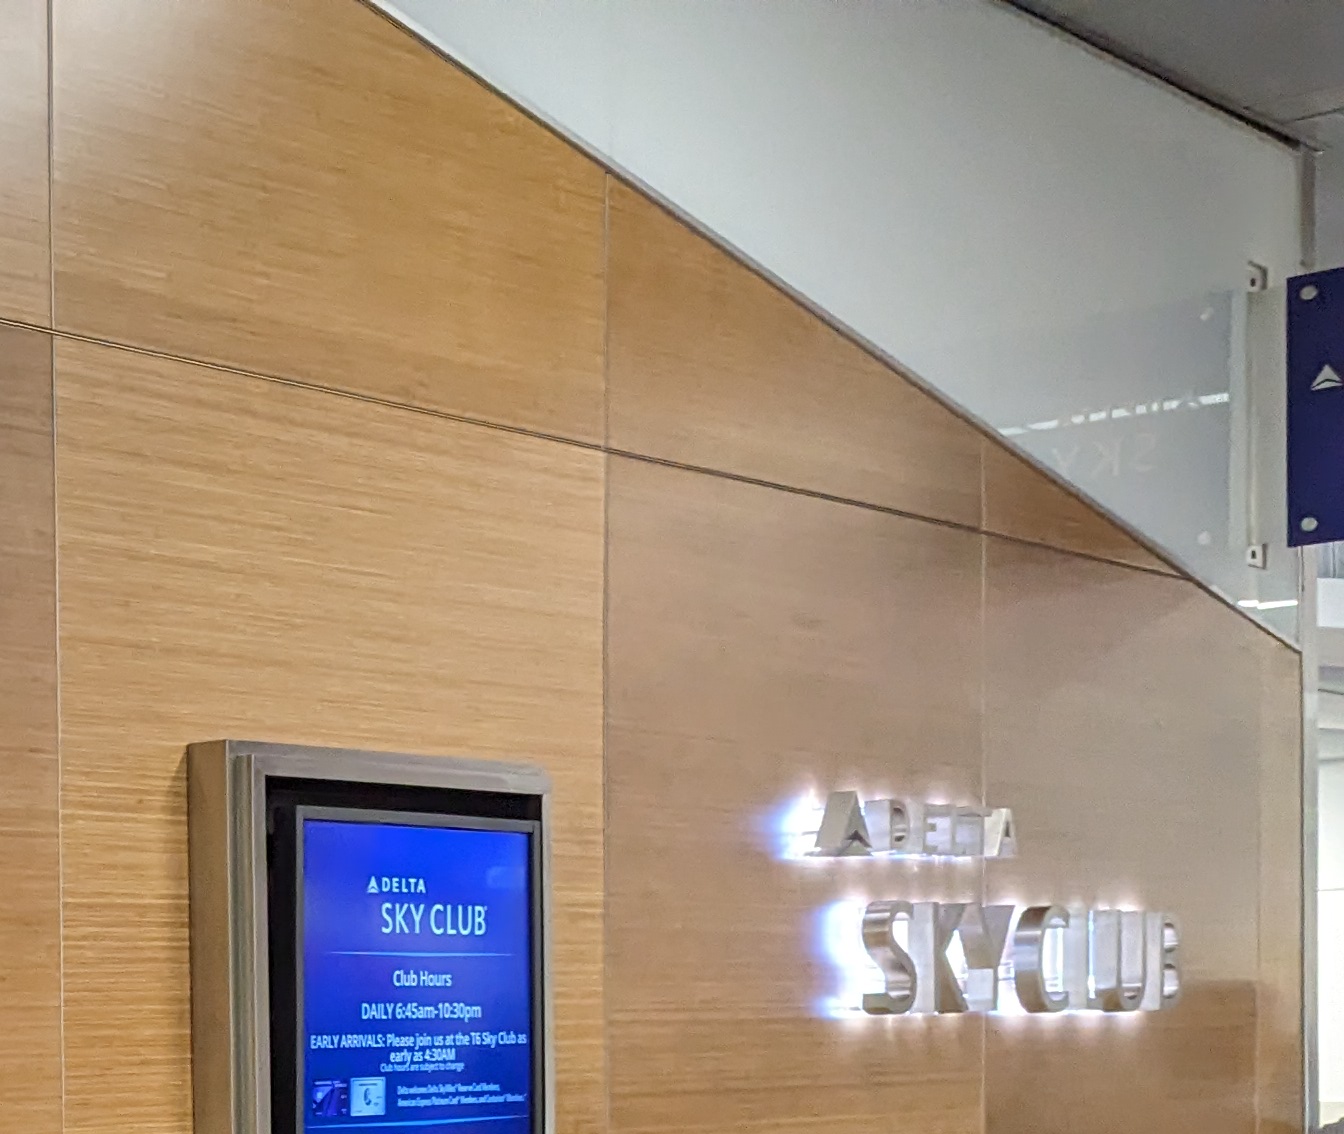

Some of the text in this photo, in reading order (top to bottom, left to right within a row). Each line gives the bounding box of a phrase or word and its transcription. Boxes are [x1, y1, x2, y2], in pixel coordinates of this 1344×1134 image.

[864, 798, 1017, 858] DELTA
[381, 877, 426, 893] DELTA
[381, 902, 486, 935] SKY CLUB
[862, 900, 1182, 1014] SKY CLUB
[393, 970, 452, 986] Club Hours
[361, 1002, 482, 1022] DAILY 6:45am-10:30pm
[310, 1034, 339, 1049] EARLY
[340, 1033, 385, 1048] ARRIVALS:
[386, 1033, 414, 1047] Please
[415, 1033, 432, 1050] join
[434, 1035, 443, 1045] us
[445, 1034, 454, 1045] at
[455, 1032, 470, 1045] the
[482, 1032, 497, 1048] Sky
[498, 1031, 516, 1044] Club
[517, 1033, 527, 1044] as
[389, 1048, 456, 1066] early as 4:30AM
